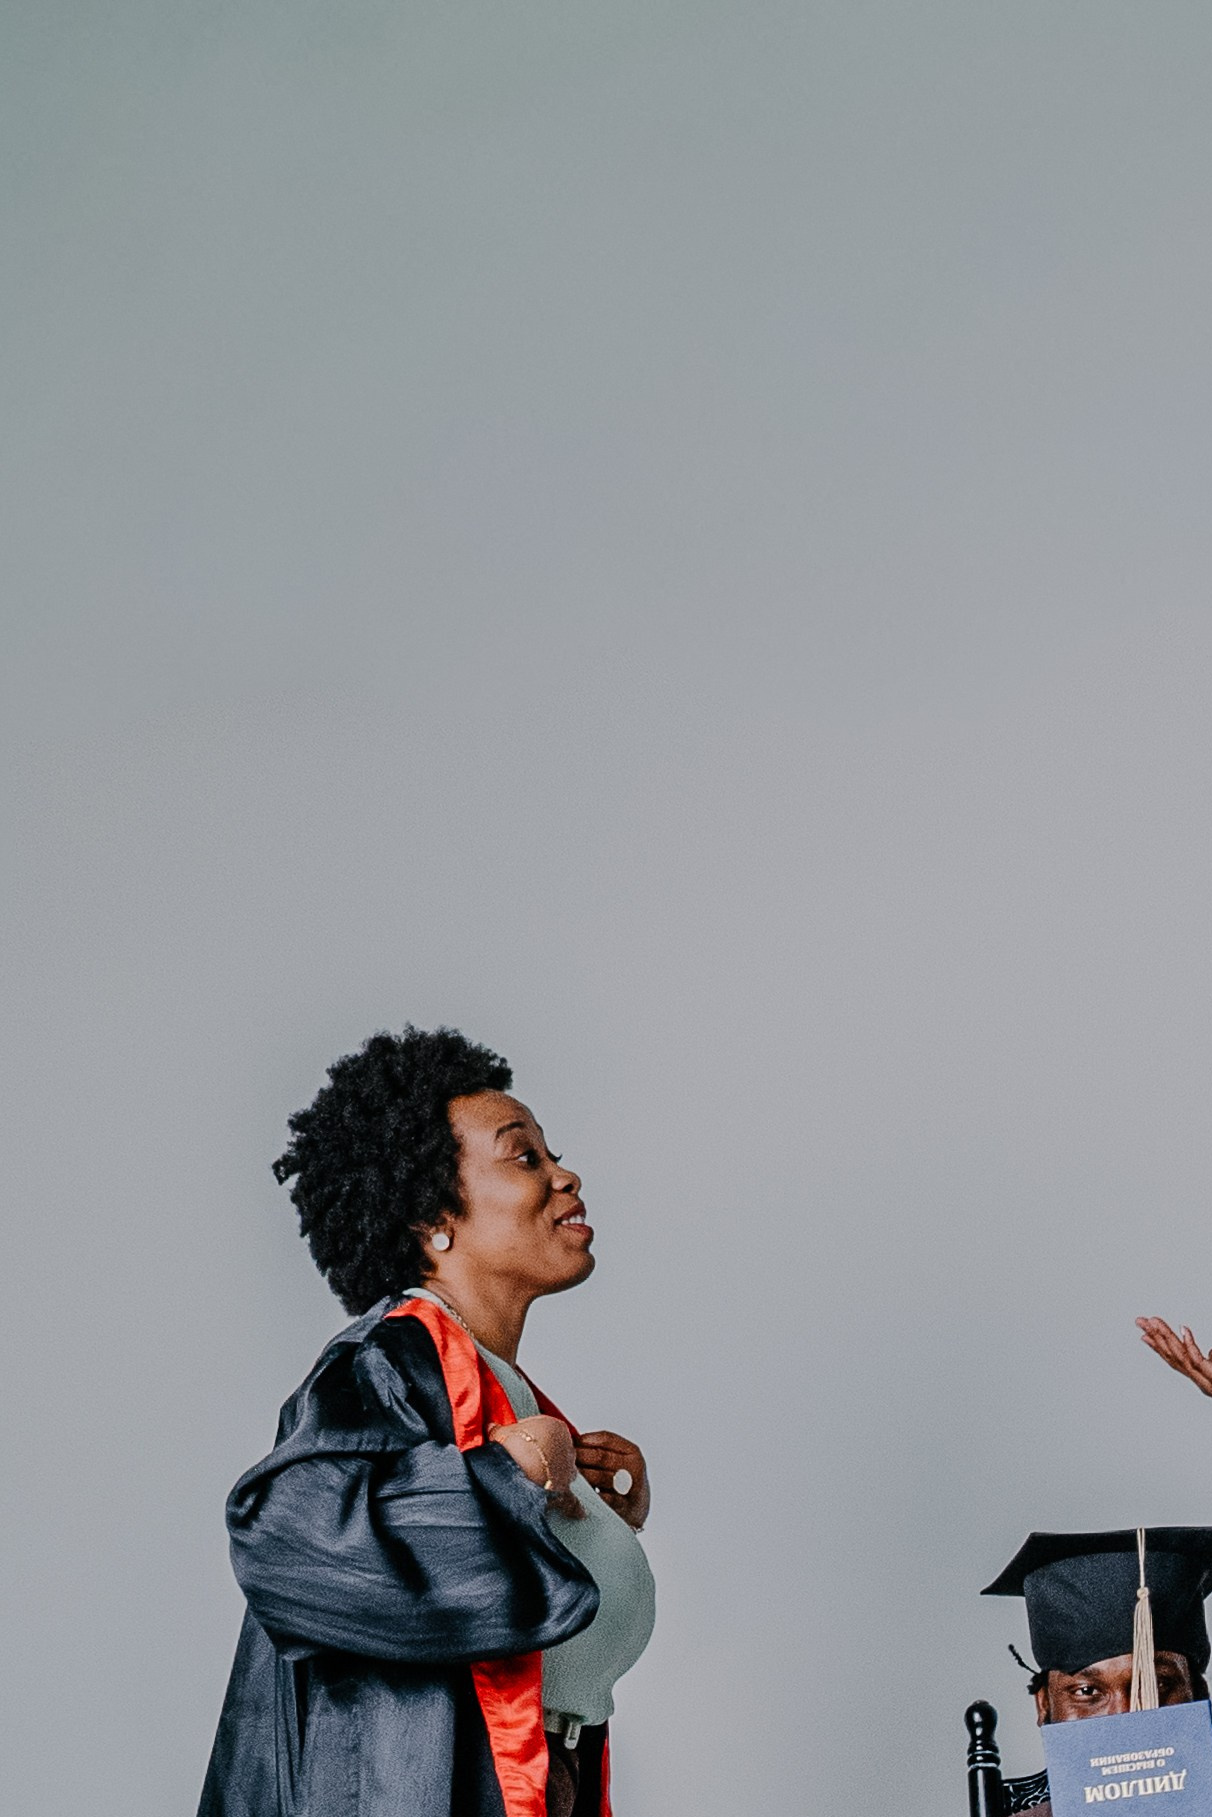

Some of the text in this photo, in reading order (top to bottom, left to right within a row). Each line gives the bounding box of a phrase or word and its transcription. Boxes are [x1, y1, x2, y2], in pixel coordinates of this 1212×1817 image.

[1090, 1747, 1175, 1767] ОБРАЗОВАНИИ
[1102, 1758, 1165, 1776] О ВЫСШЕМ
[1084, 1769, 1187, 1803] ДИПЛОМ
